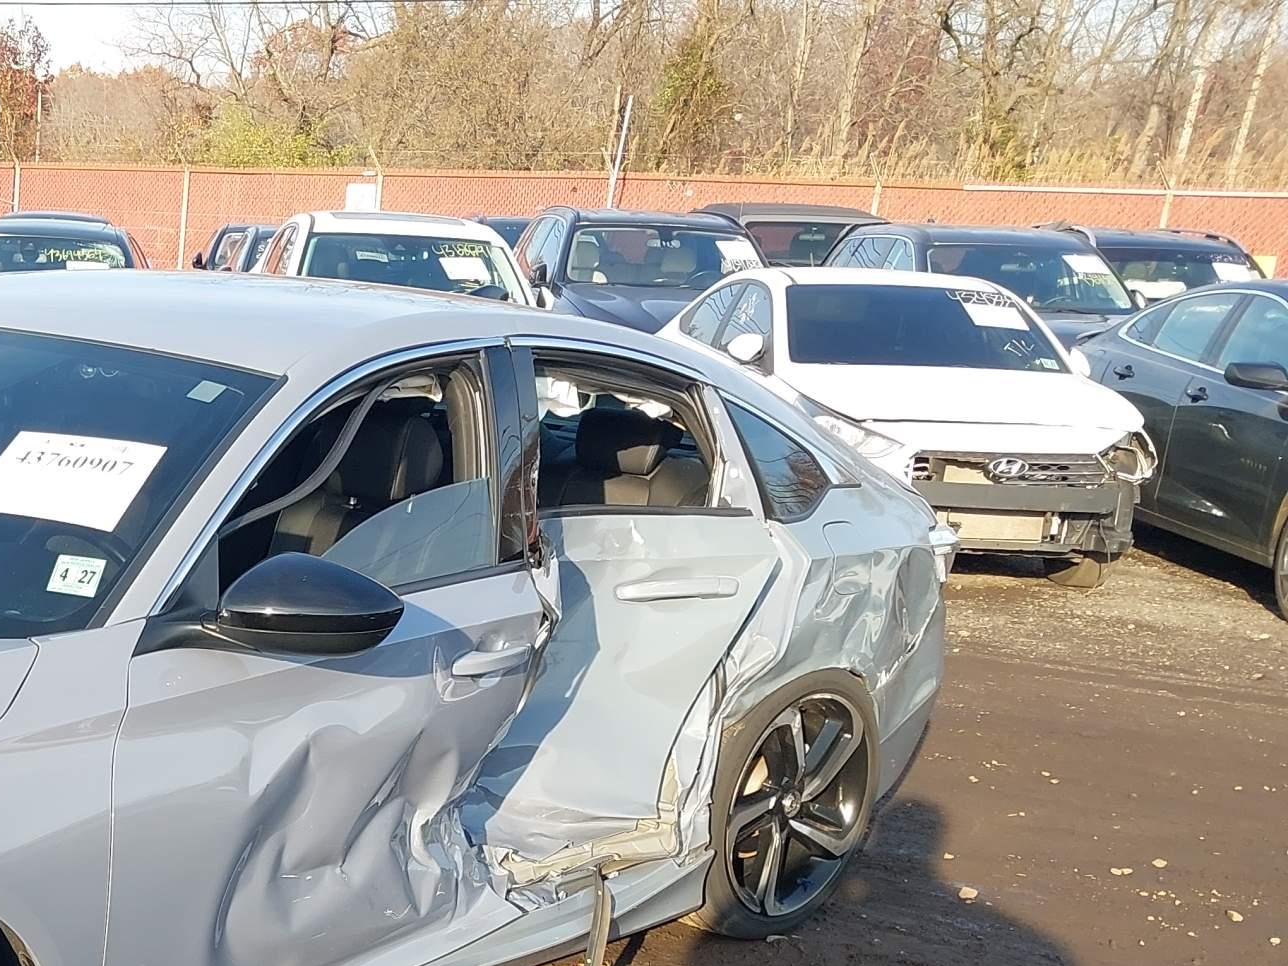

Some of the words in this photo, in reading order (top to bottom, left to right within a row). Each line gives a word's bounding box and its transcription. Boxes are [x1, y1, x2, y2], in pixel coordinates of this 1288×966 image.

[15, 450, 136, 475] 43760907
[59, 567, 70, 582] 4
[77, 569, 97, 585] 27
